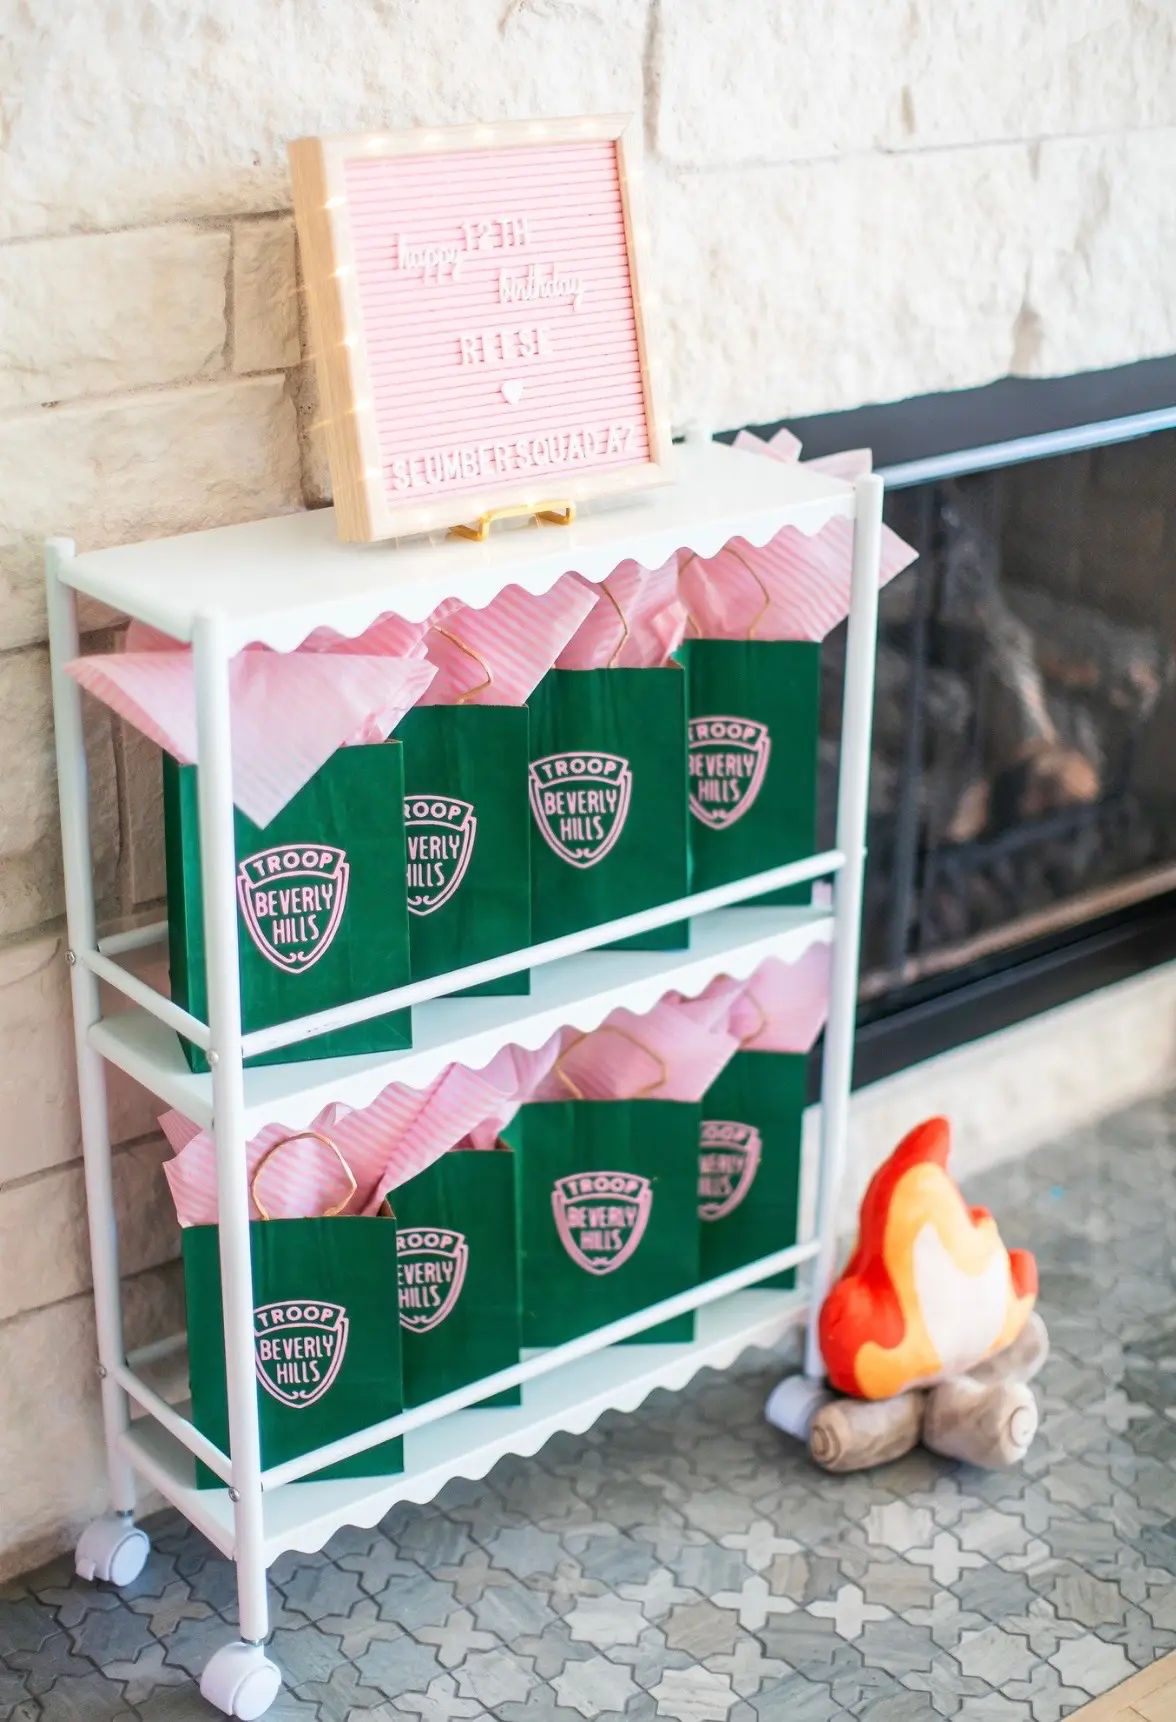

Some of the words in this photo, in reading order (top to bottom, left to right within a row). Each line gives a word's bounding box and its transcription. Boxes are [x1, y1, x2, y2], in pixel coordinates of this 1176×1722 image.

[397, 233, 463, 284] happy
[461, 217, 530, 251] 12TH
[500, 264, 584, 312] birthday
[461, 328, 550, 365] REESE
[541, 757, 617, 779] TROOP
[544, 789, 617, 816] BEVERLY
[698, 778, 741, 803] HILLS
[404, 801, 461, 820] ROOP
[560, 816, 604, 841] HILLS
[408, 835, 460, 860] VERLY
[252, 850, 334, 877] TROOP
[255, 884, 333, 918] BEVERLY
[272, 915, 320, 945] HILLS
[567, 1176, 638, 1196] TROOP
[396, 1233, 453, 1250] ROOP
[397, 1261, 454, 1285] EVERLY
[398, 1285, 441, 1309] HILLS
[257, 1306, 334, 1327] TROOP
[259, 1335, 334, 1361] BEVERLY
[276, 1360, 321, 1385] HILLS
